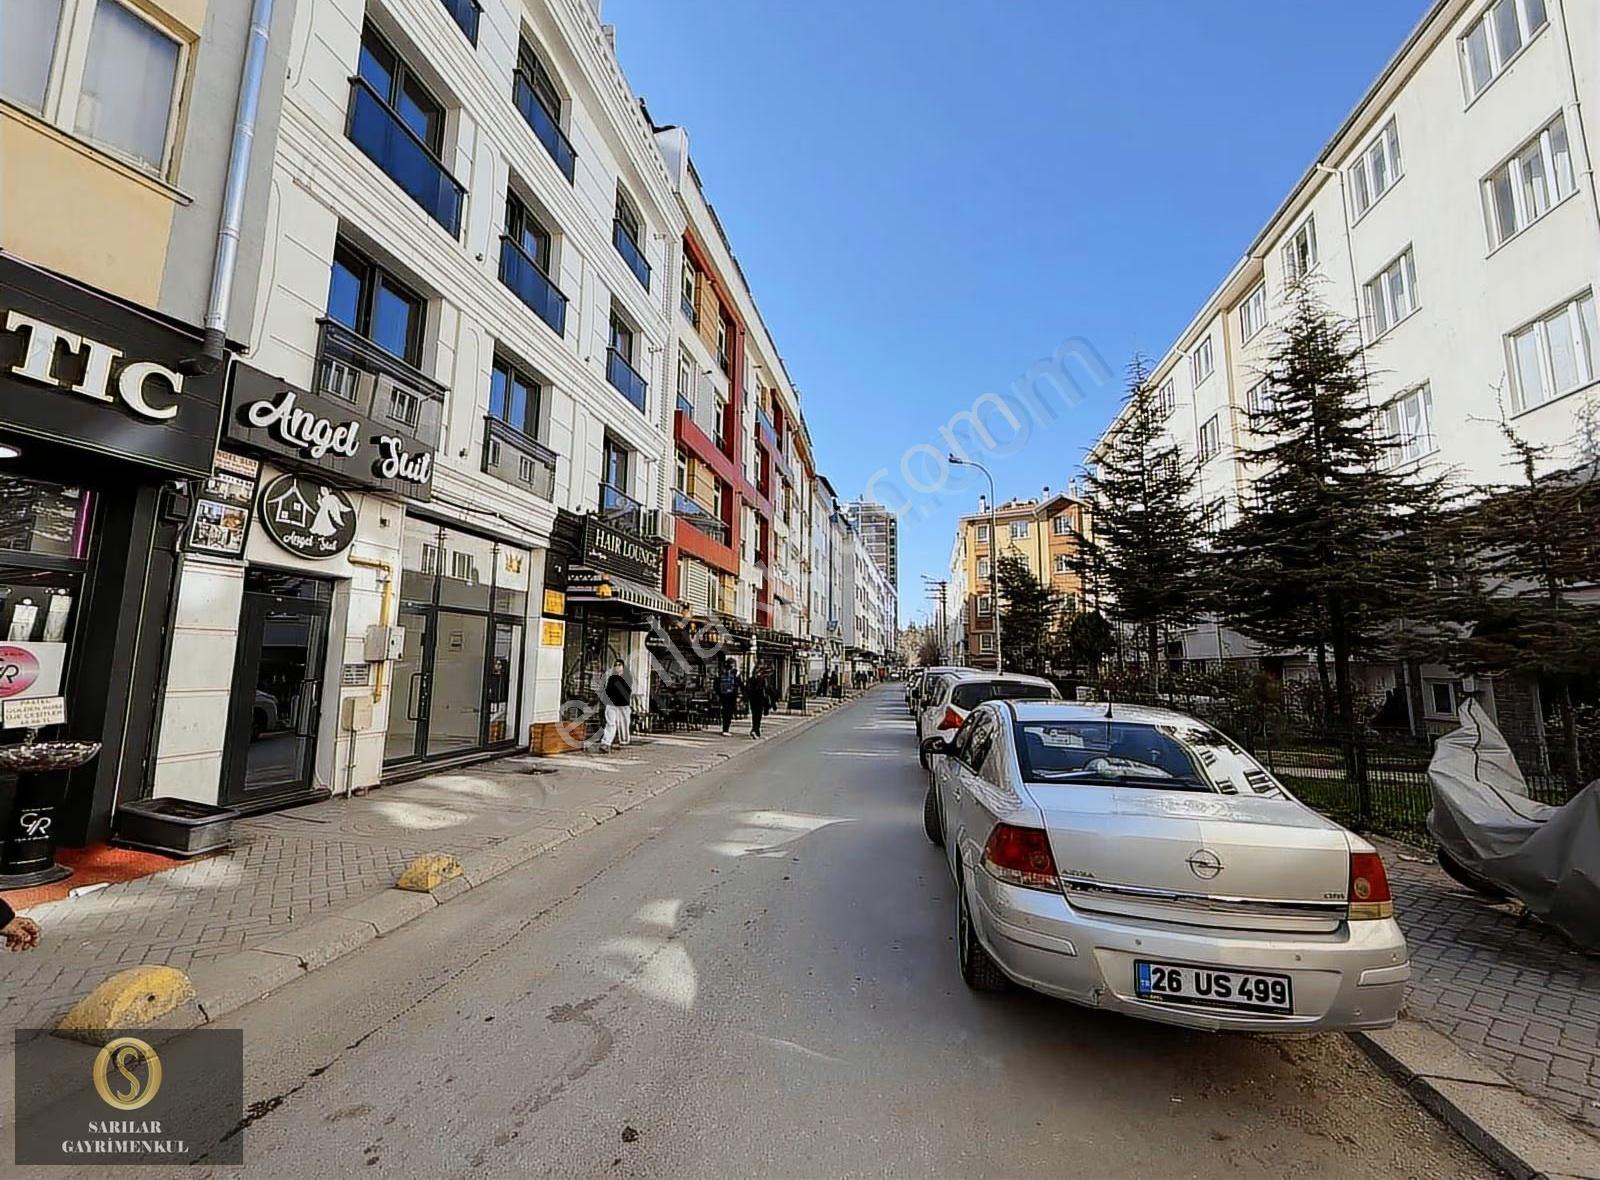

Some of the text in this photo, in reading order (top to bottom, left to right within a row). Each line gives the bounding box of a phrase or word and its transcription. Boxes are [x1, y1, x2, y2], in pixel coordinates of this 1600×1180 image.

[248, 391, 360, 459] Angel
[595, 528, 622, 555] HAIR
[622, 539, 658, 569] LOUNGE
[1151, 966, 1287, 1005] 26 US 499
